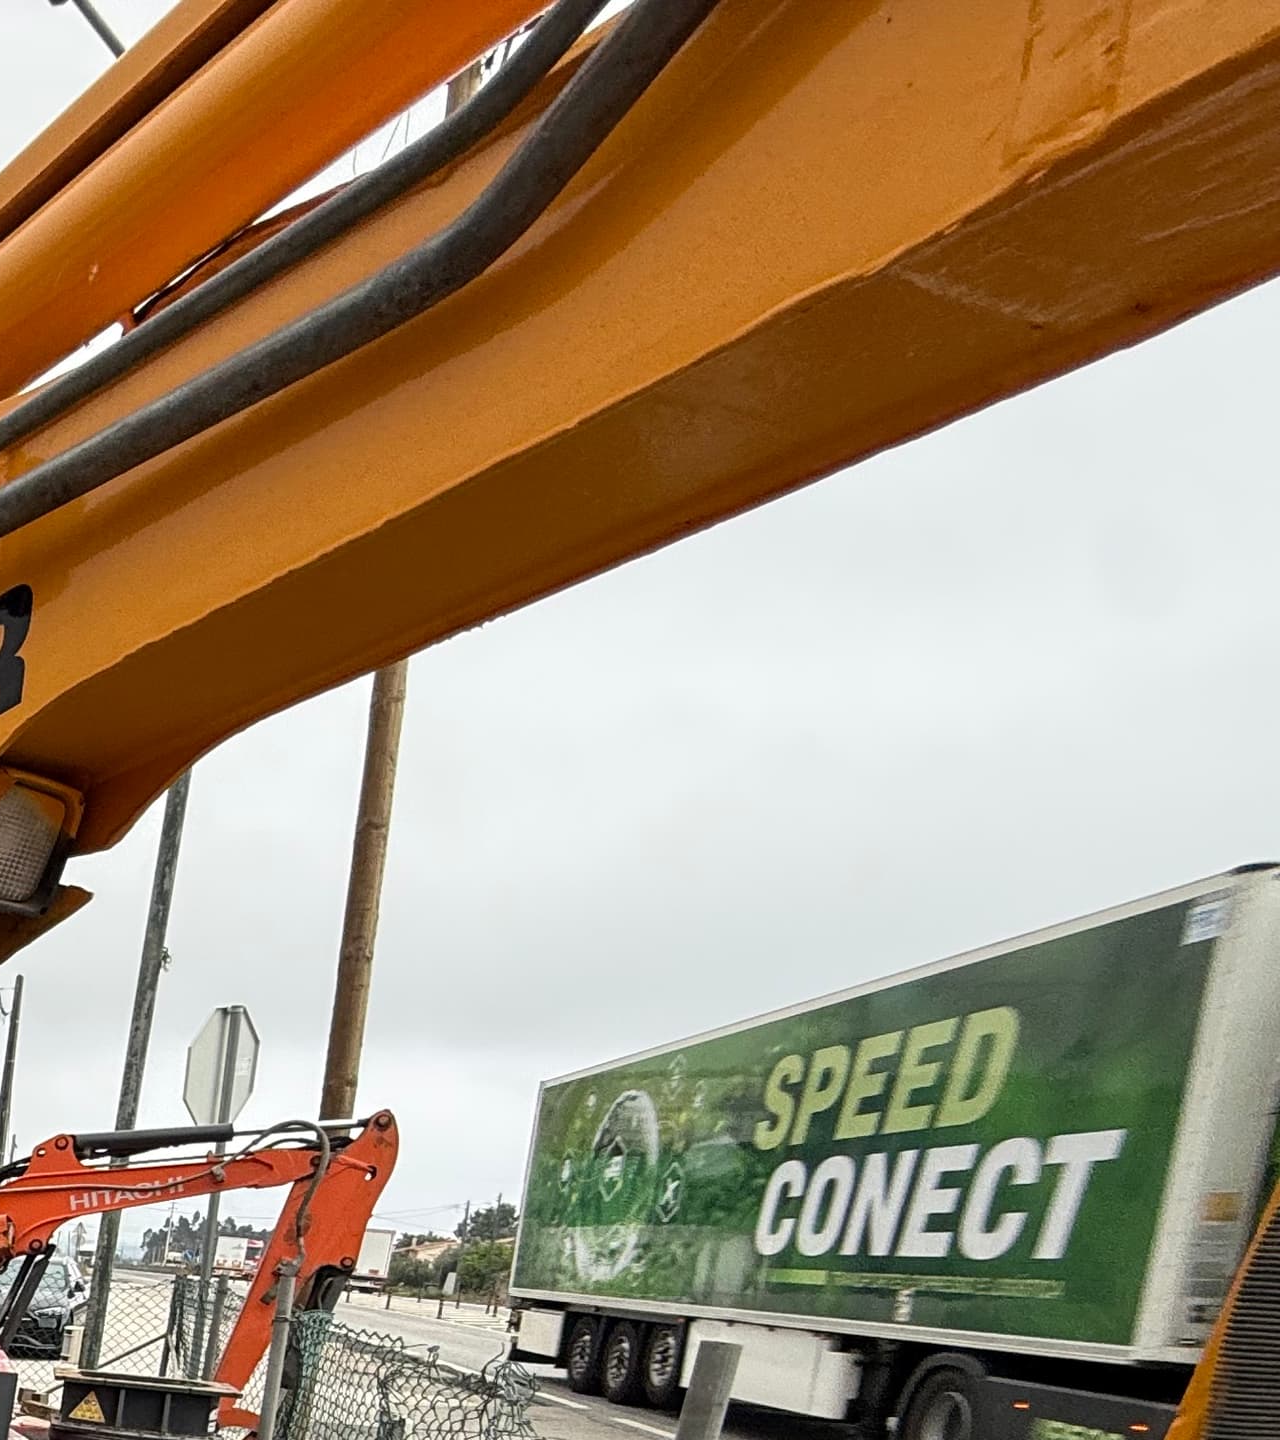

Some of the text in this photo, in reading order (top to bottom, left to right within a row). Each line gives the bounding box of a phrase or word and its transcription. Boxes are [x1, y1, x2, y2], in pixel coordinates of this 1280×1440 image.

[753, 1006, 1020, 1151] SPEED
[69, 1175, 185, 1212] HITACHI
[754, 1128, 1128, 1260] CONECT
